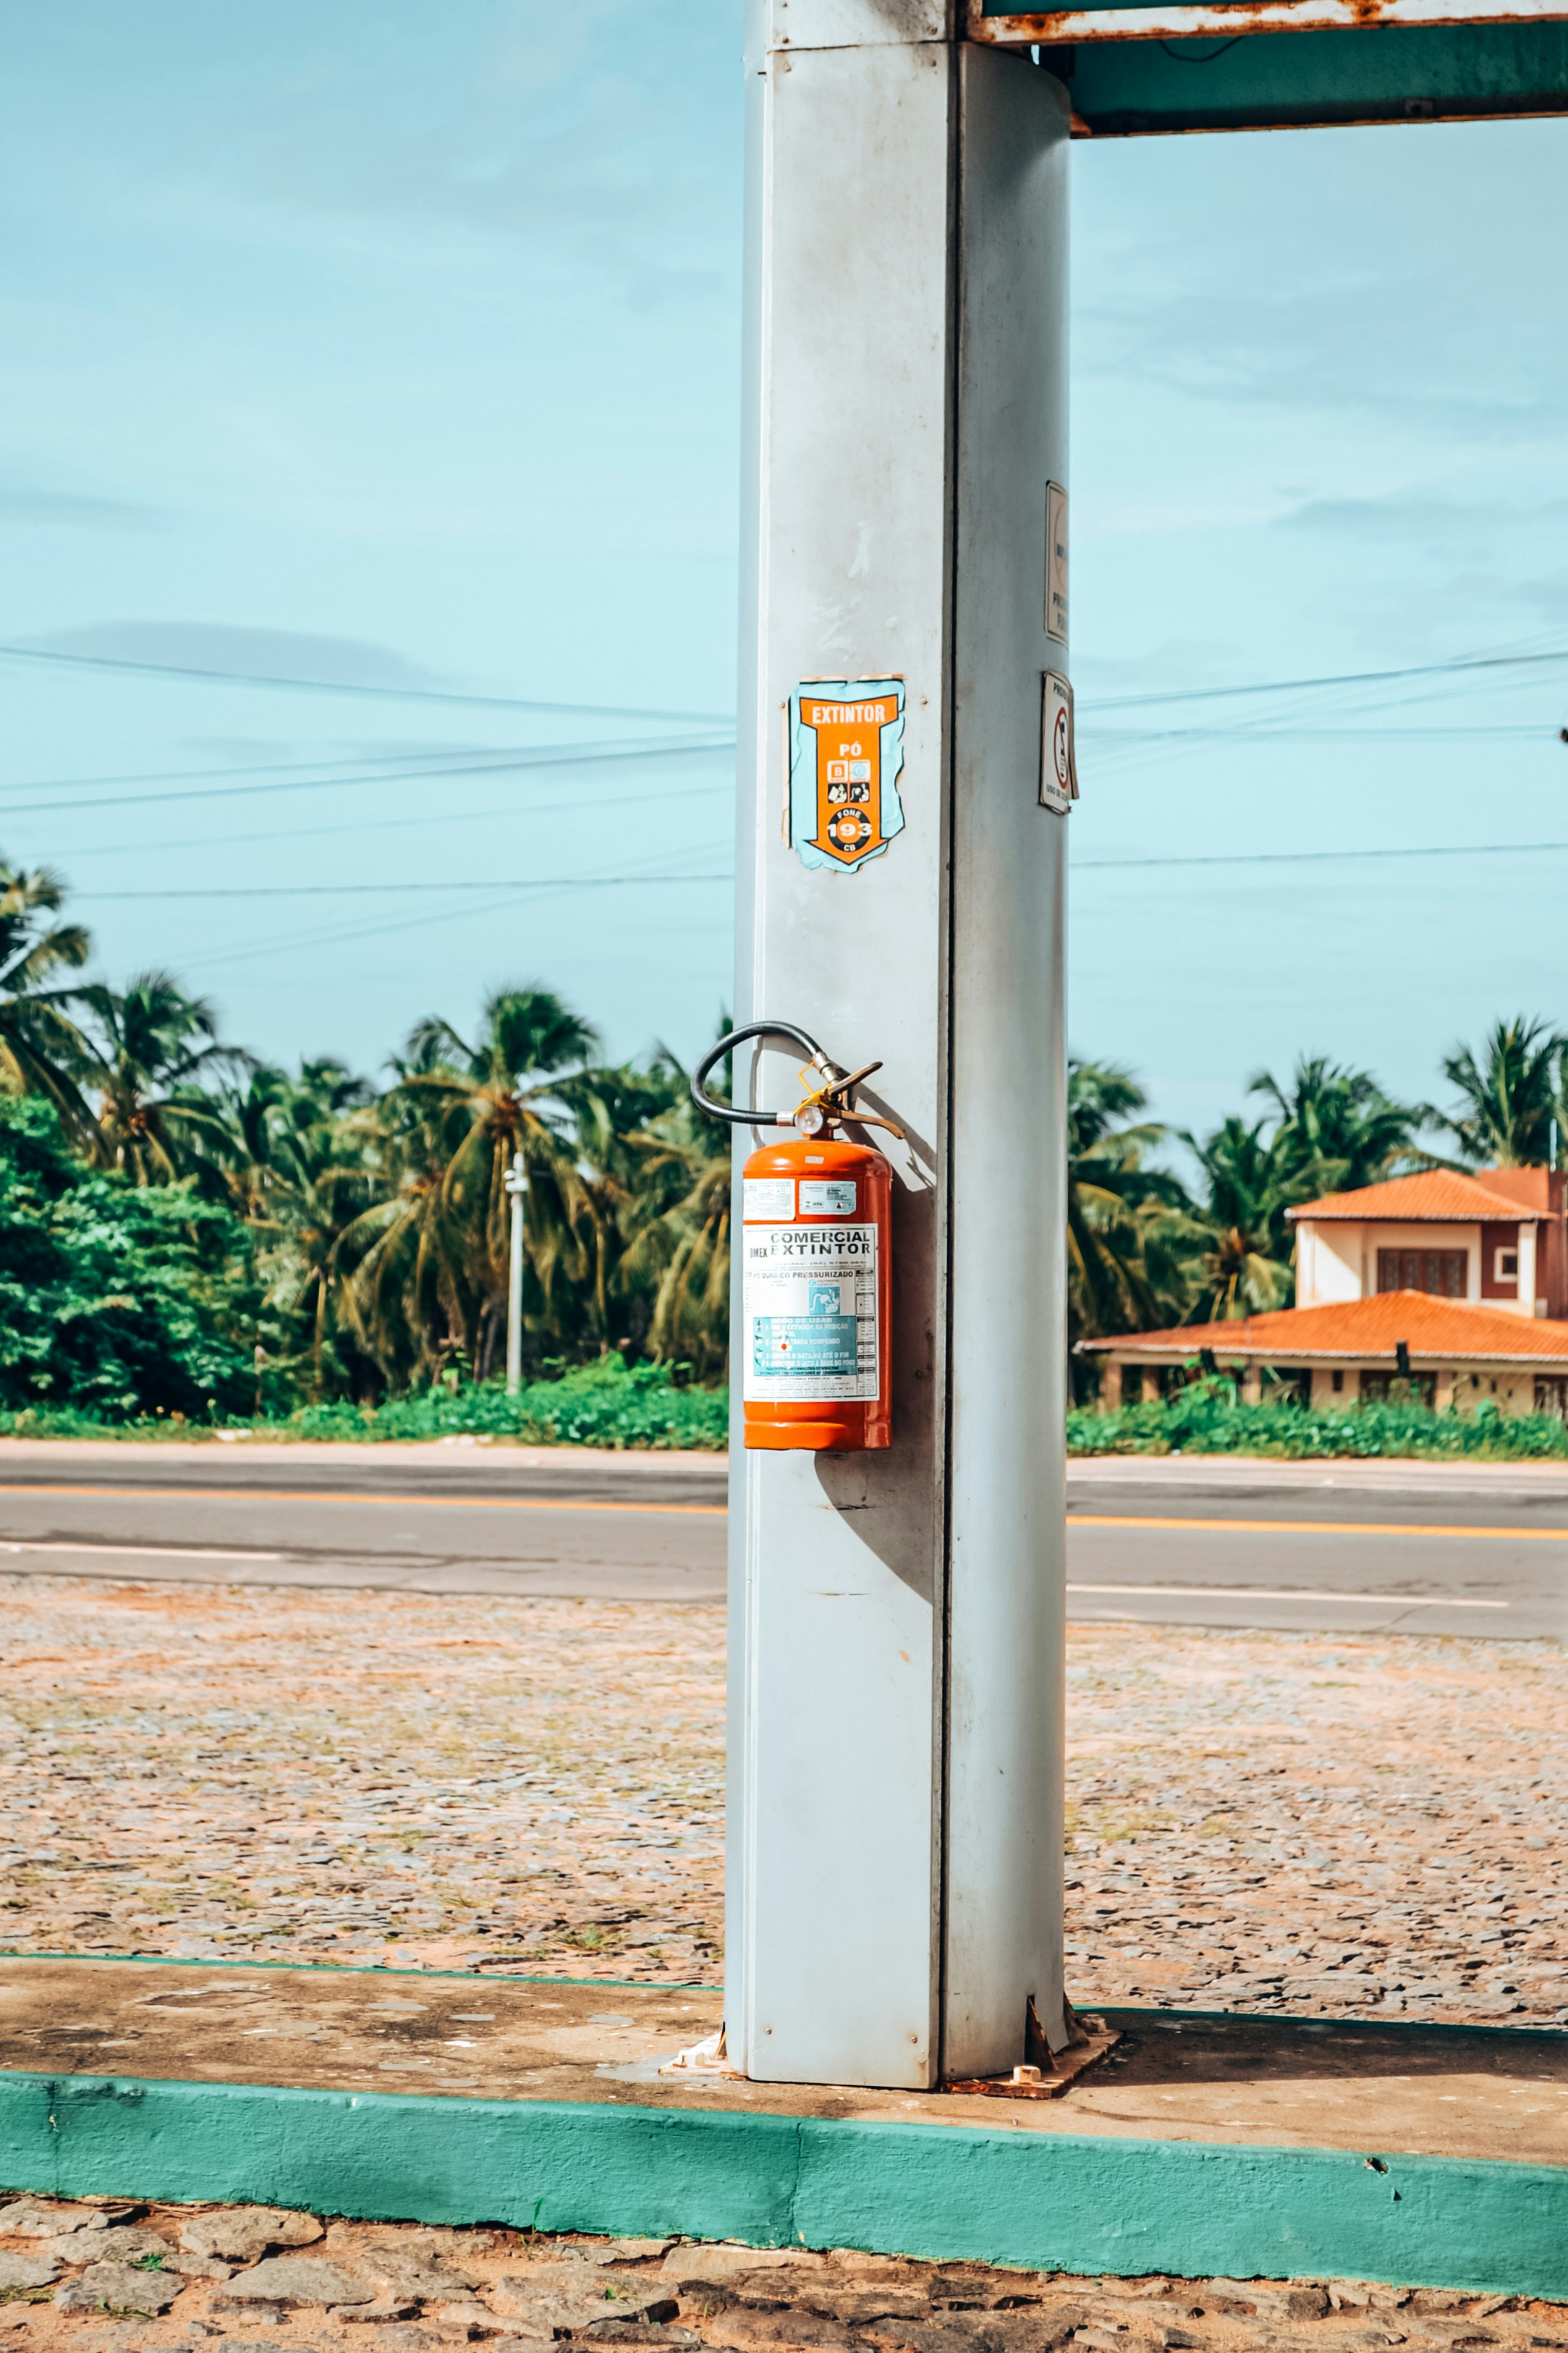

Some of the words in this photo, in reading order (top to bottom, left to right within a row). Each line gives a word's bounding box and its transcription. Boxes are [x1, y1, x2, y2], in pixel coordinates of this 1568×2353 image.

[812, 704, 885, 724] EXTINTOR
[839, 741, 861, 756] PÓ
[834, 766, 842, 777] B
[837, 808, 861, 819] FONE
[827, 822, 873, 837] 193
[844, 842, 856, 852] CB
[771, 1231, 870, 1243] COMERCIAL
